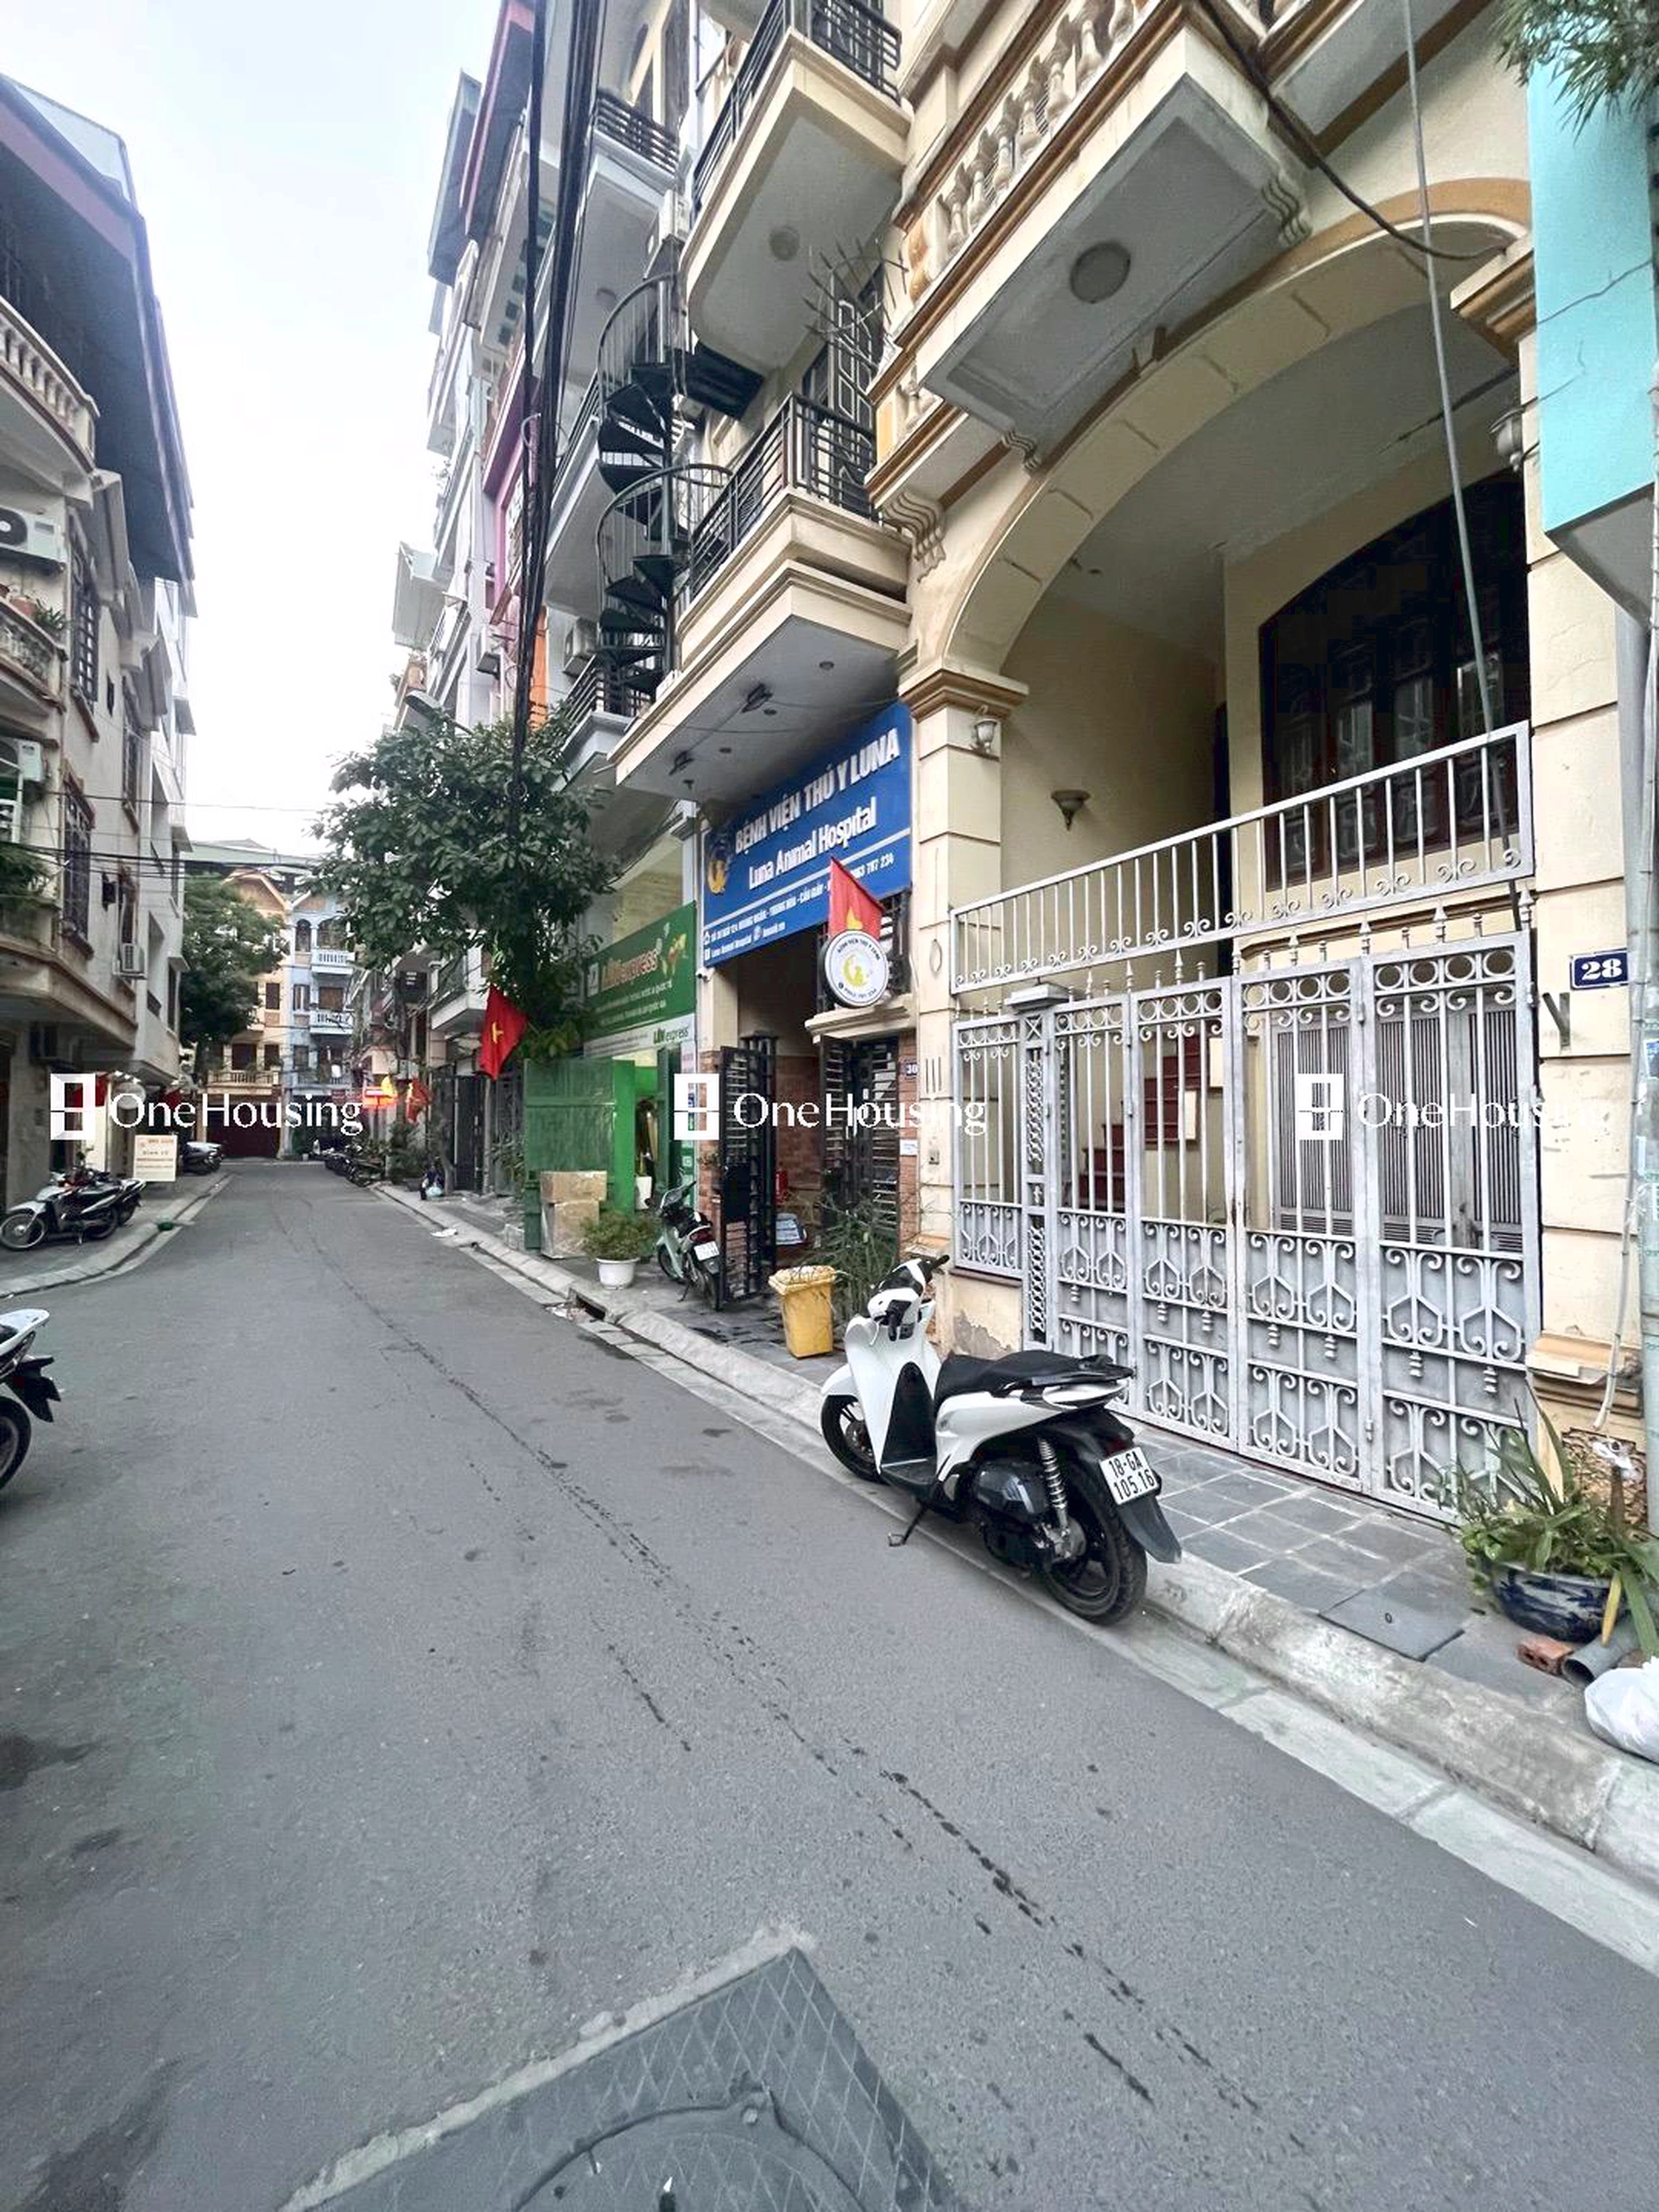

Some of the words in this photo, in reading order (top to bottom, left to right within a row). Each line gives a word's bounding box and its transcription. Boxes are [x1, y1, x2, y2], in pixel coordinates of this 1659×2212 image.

[736, 814, 767, 855] BỆNH
[769, 791, 801, 831] VIỆN
[837, 760, 849, 791] Y
[850, 727, 901, 784] LUNA
[749, 861, 774, 890] Luna
[819, 796, 877, 853] Hospital
[1581, 958, 1623, 980] 28
[906, 1063, 918, 1074] 30
[1113, 1469, 1156, 1500] 105.16
